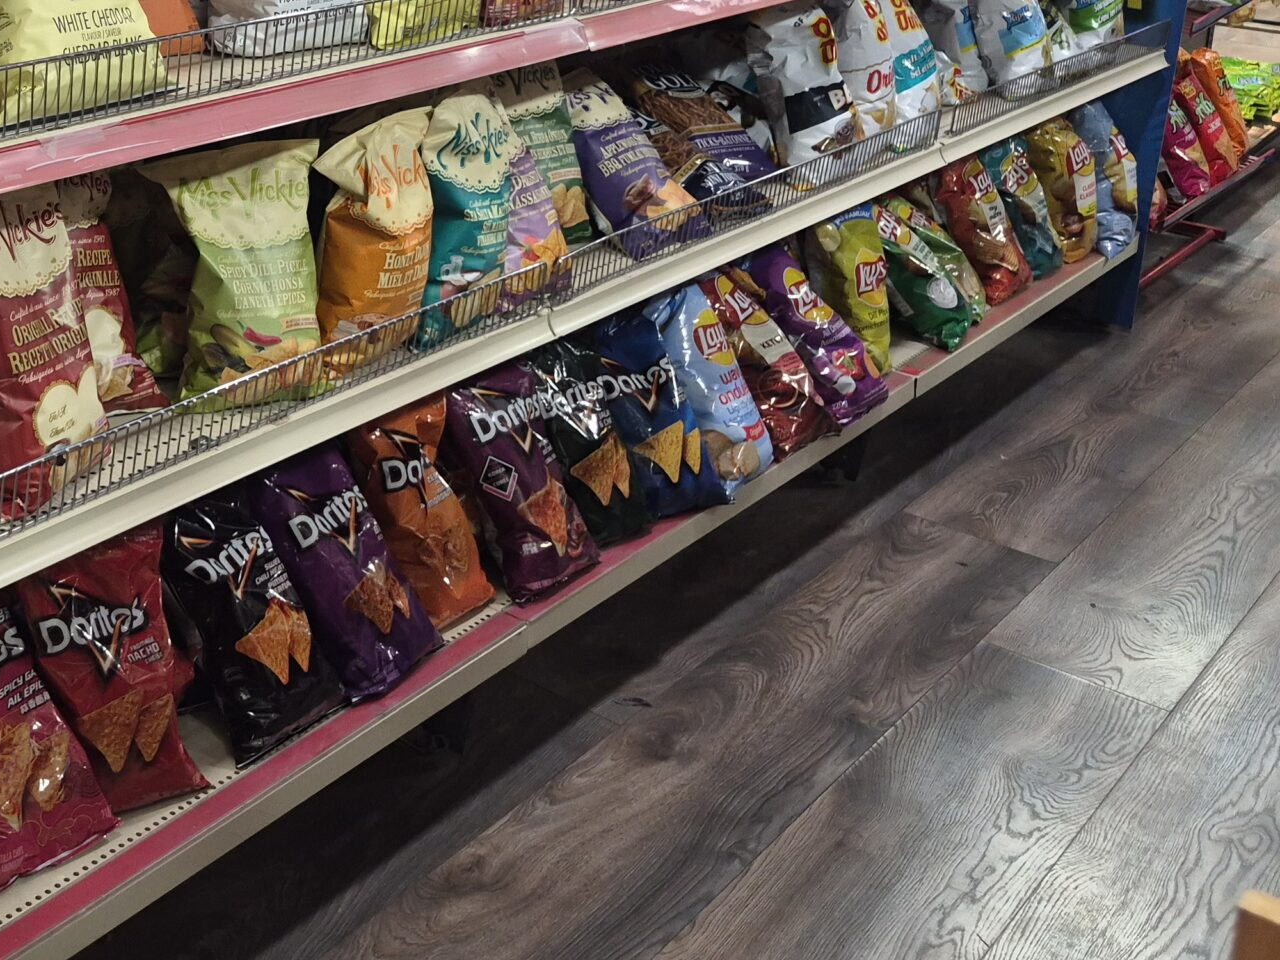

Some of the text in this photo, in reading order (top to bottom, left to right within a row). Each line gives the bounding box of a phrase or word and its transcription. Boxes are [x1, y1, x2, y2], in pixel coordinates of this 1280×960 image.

[52, 6, 136, 34] WHITE CHEDDAR
[76, 247, 113, 268] RECIPE
[219, 262, 248, 280] SPICY
[277, 259, 308, 274] PICKLE
[471, 390, 541, 443] Doritos
[288, 484, 368, 551] Doritos
[184, 524, 273, 585] Doritos
[39, 596, 147, 655] Doritos
[7, 694, 23, 709] AIL
